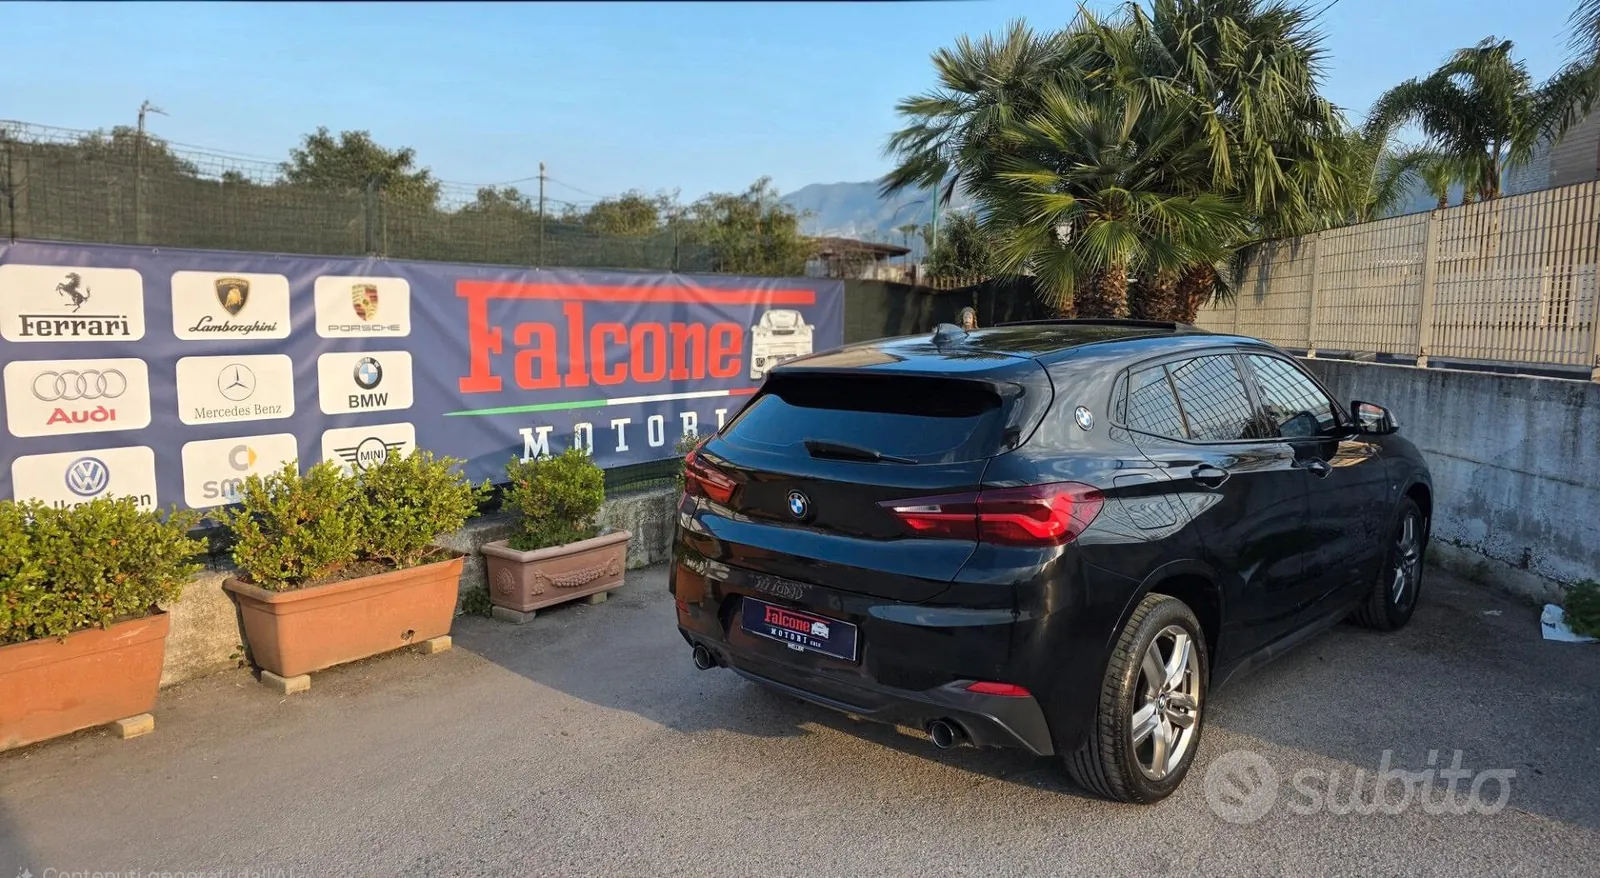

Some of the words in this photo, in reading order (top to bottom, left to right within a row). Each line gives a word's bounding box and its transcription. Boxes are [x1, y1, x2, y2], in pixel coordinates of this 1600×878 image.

[19, 315, 130, 337] Ferrari
[188, 316, 278, 335] Lamborghini
[328, 324, 400, 332] PORSCHE
[456, 280, 815, 393] Falcone
[348, 393, 389, 409] BMW
[46, 406, 116, 425] Audi
[194, 408, 250, 419] Mercedes
[254, 405, 282, 415] Benz
[519, 409, 728, 463] MOTORI
[360, 450, 384, 461] MINI
[764, 606, 831, 632] Falcone
